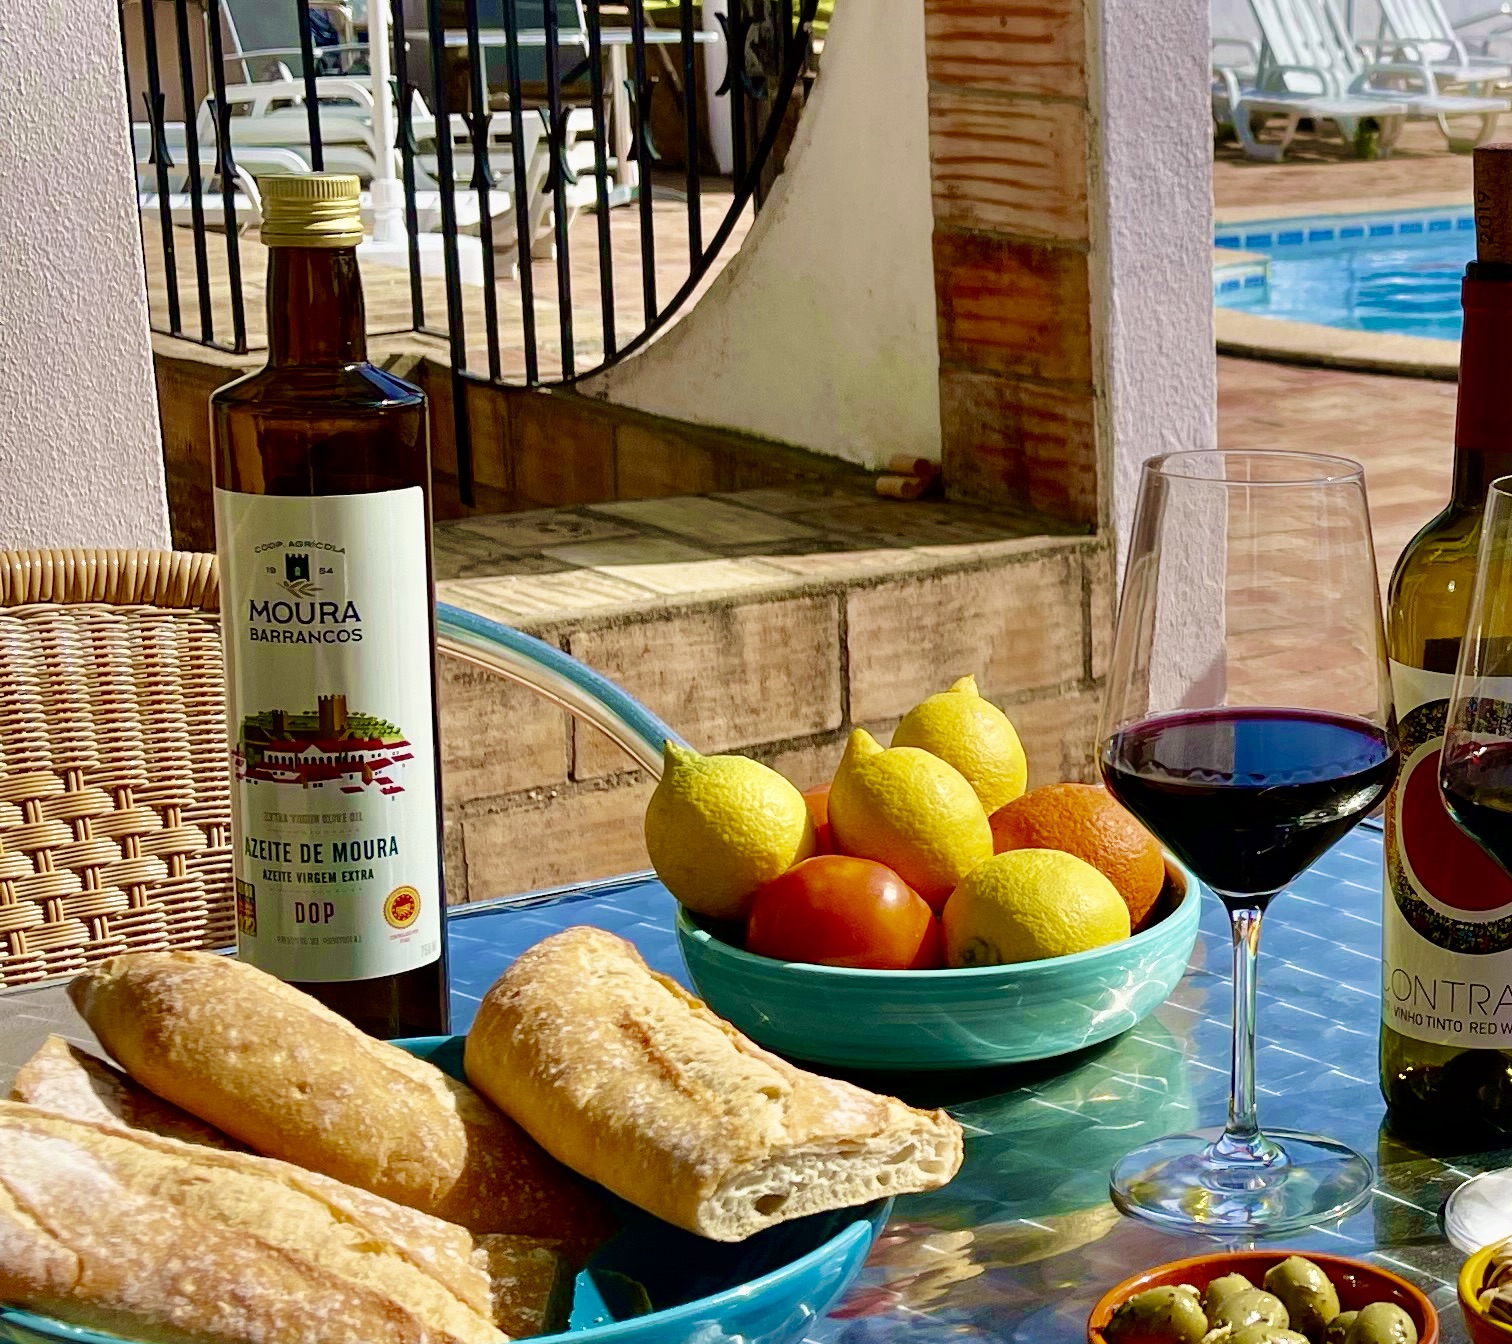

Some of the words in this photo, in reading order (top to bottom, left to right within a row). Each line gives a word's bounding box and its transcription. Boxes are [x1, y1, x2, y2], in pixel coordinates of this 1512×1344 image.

[249, 599, 362, 625] MOURA
[249, 627, 363, 644] BARRANCOS
[245, 836, 293, 863] AZEITE
[300, 843, 324, 864] DE
[332, 835, 399, 863] MOURA
[262, 868, 293, 883] AZEITE
[296, 870, 337, 884] VIRGEM
[341, 868, 375, 883] EXTRA
[294, 901, 335, 924] DOP
[1393, 1004, 1423, 1026] VINHO
[1425, 1014, 1463, 1033] TINTO
[1469, 1021, 1497, 1035] RED
